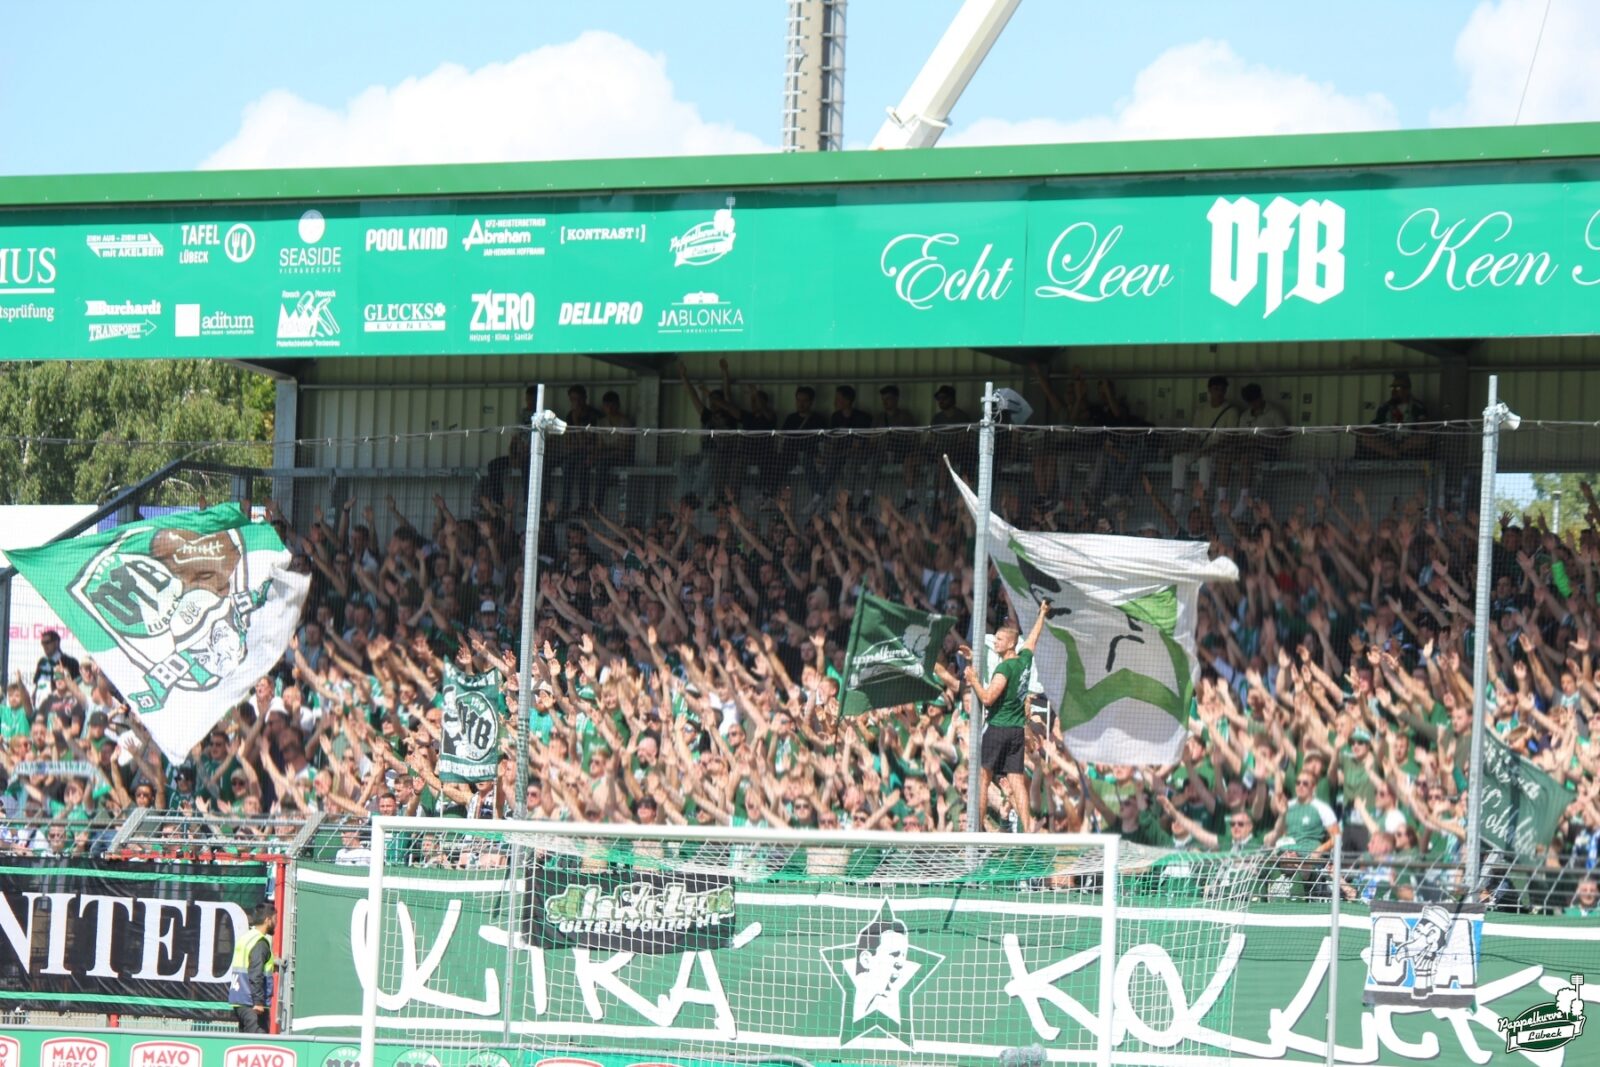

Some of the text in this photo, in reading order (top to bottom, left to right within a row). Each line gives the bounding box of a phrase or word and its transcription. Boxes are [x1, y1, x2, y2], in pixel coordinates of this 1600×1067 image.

[181, 224, 220, 245] TAFEL
[460, 217, 532, 252] Abraham
[180, 250, 208, 264] LÜBECK
[280, 247, 341, 267] SEASIDE
[1385, 208, 1556, 291] Keen
[0, 247, 56, 284] US
[201, 308, 256, 330] aditum
[363, 301, 434, 321] GLÜCKS
[559, 301, 643, 325] DELLPRO
[656, 307, 745, 328] JABLONKA
[559, 919, 620, 933] ULTRA
[52, 1046, 98, 1062] MAYO
[142, 1050, 190, 1065] MAYO
